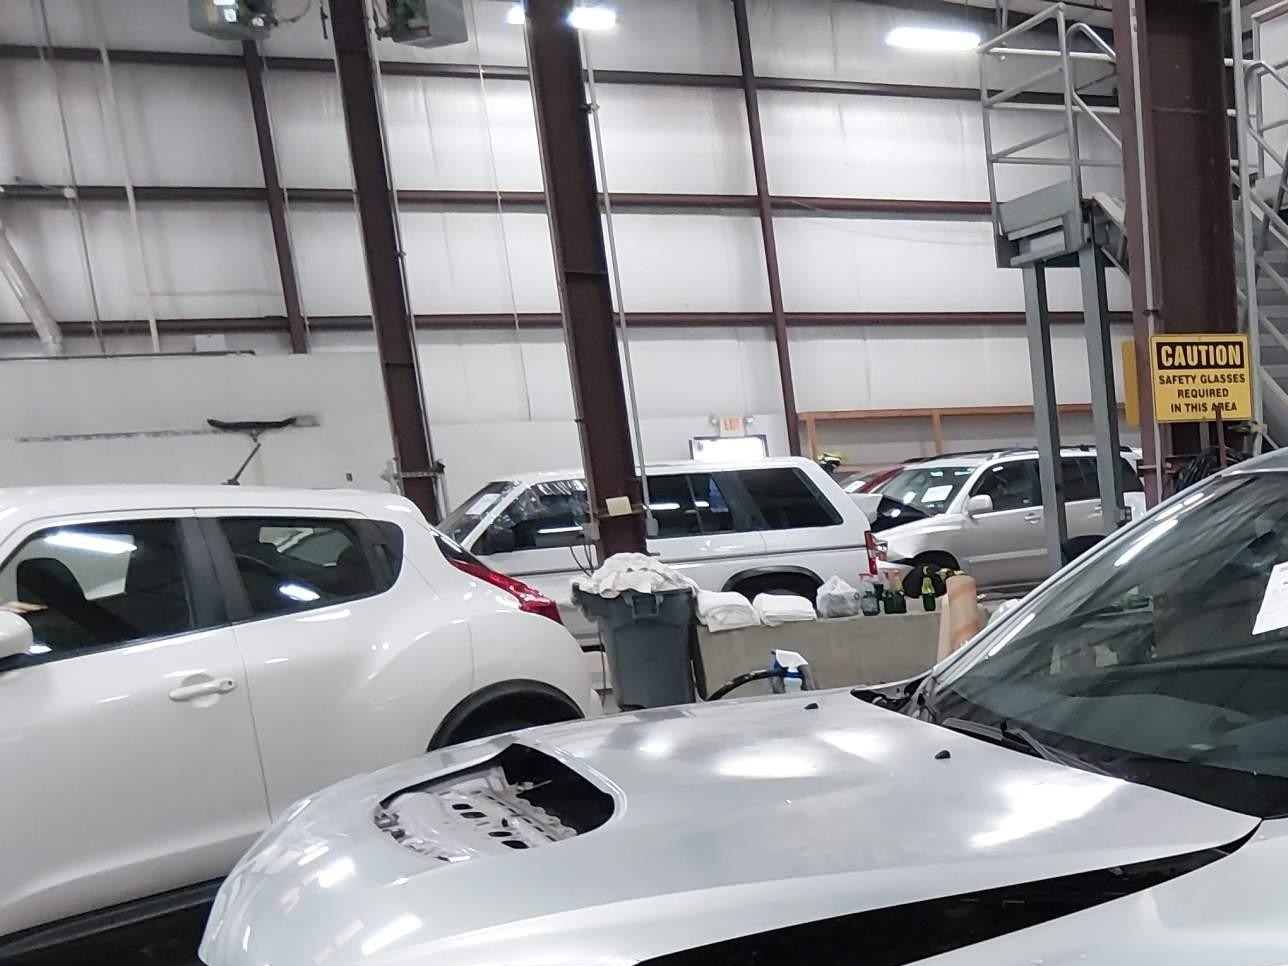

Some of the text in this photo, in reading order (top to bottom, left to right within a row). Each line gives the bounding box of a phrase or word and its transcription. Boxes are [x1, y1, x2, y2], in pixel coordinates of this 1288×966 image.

[1160, 344, 1241, 367] CAUTION
[1159, 373, 1245, 385] SAFETY GLASSES
[1177, 388, 1229, 399] REQUIRED
[1171, 403, 1182, 413] IN
[1185, 402, 1208, 413] THIS
